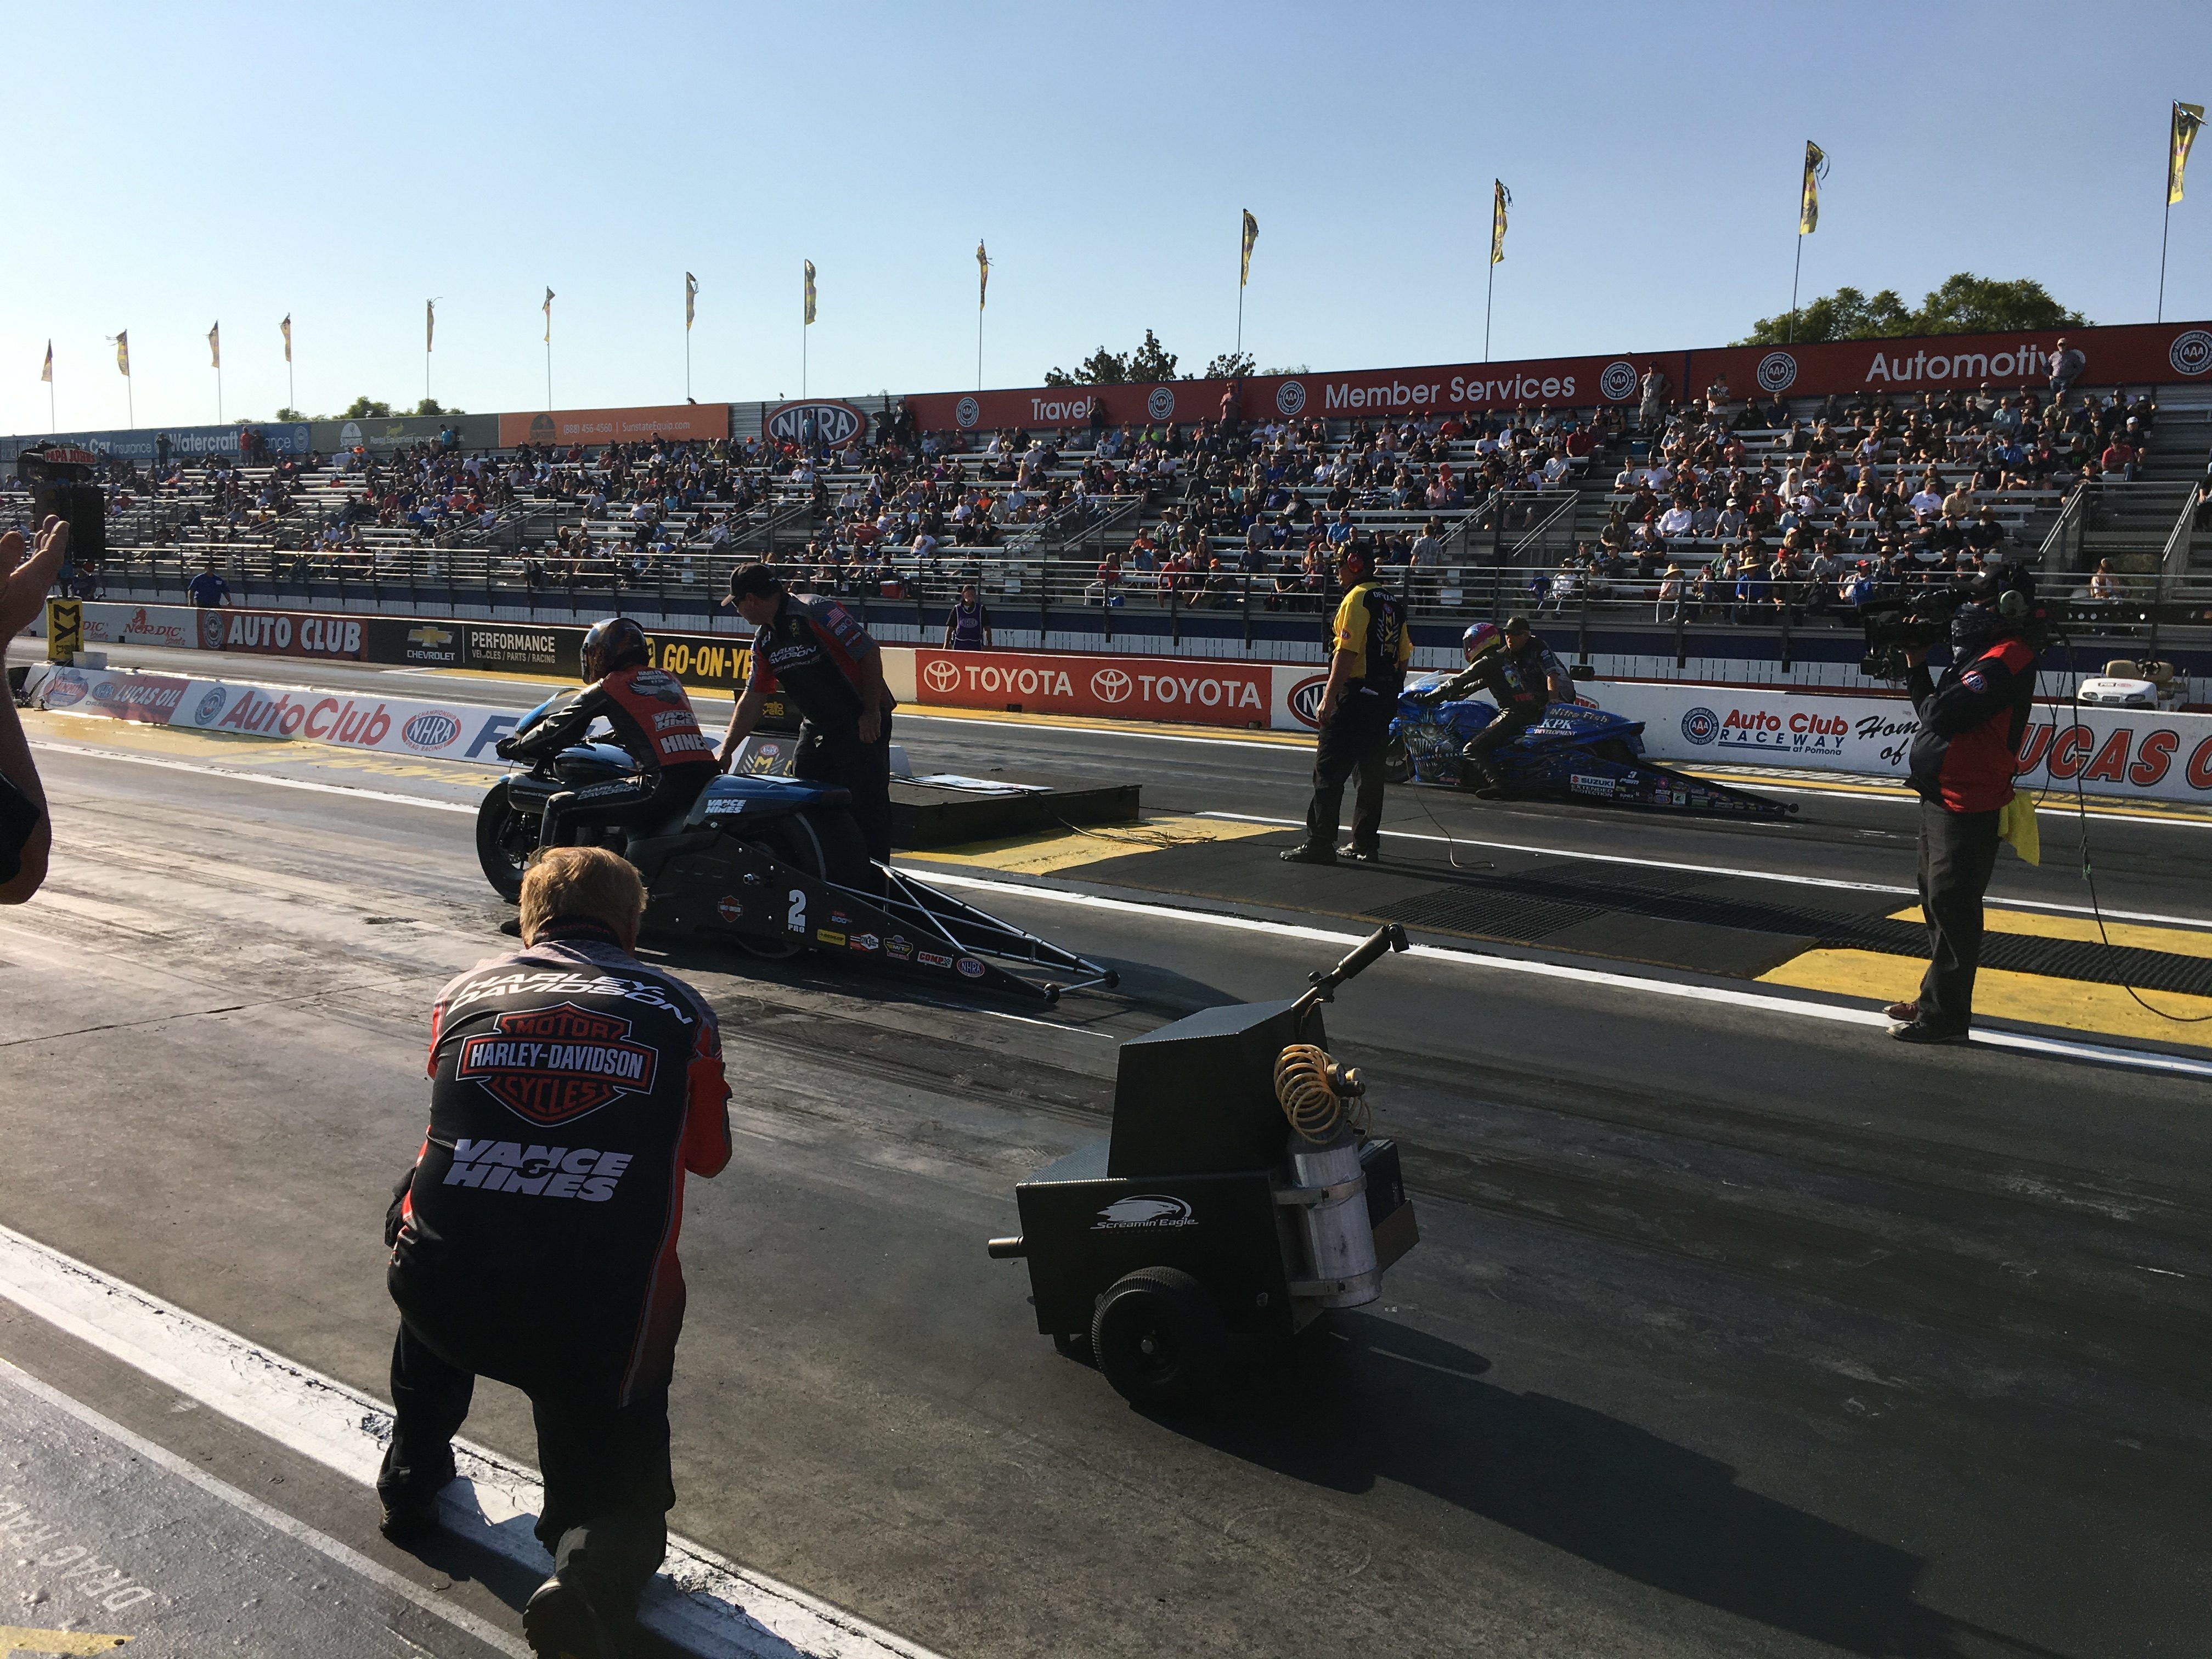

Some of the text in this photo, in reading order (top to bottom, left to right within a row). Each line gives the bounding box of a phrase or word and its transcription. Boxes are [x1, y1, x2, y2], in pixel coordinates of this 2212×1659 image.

[2183, 346, 2204, 357] AAA
[1865, 344, 2086, 382] Automoti
[1768, 366, 1785, 376] AAA
[1611, 375, 1626, 384] AAA
[1285, 392, 1297, 401] AAA
[1325, 373, 1576, 409] Member Services
[1031, 396, 1091, 421] Travel
[1155, 398, 1166, 407] AAA
[563, 421, 691, 435] (888) 456-4560 SunstateEquip.com
[777, 408, 850, 445] NHRA
[113, 441, 152, 454] Insurance
[169, 431, 239, 452] Watercraft
[46, 449, 68, 461] PAPA
[1373, 591, 1397, 602] OFCIAL
[123, 623, 181, 636] NORDIC
[227, 616, 362, 652] AUTO CLUB
[471, 631, 556, 653] PERFORMANCE
[407, 650, 455, 661] CHEVROLET
[507, 653, 527, 662] PARTS
[532, 654, 556, 664] RACING
[769, 645, 804, 658] ARLEY-
[663, 644, 752, 680] GO-ON-YE
[964, 665, 1074, 697] TOYOTA
[113, 685, 183, 708] LUCAS OIL
[1137, 675, 1262, 710] TOYOTA
[417, 709, 456, 720] CHAMPIONSHIP
[1540, 719, 1574, 730] KPK
[1691, 720, 1708, 731] AAA
[1723, 709, 1849, 736] Auto Club
[1855, 715, 1921, 740] Hom
[409, 717, 453, 744] NHRA
[1719, 729, 1845, 748] RACEWAY
[405, 741, 443, 752] DRAG RACING
[1804, 746, 1842, 756] Pomona
[1880, 737, 1909, 766] of
[2012, 723, 2180, 787] UCAS
[1571, 785, 1613, 793] EXTENDED
[1581, 778, 1613, 787] SUZUKI
[577, 786, 641, 800] DAVIDSON
[1571, 788, 1613, 797] PROTECTION
[705, 806, 743, 814] HINES
[707, 799, 747, 808] VANCE
[788, 889, 806, 927] 2
[788, 924, 805, 933] PRO
[919, 952, 944, 964] COMP
[961, 961, 981, 974] NHRA
[459, 972, 666, 998] HARLEY-
[446, 982, 693, 1025] DAVIDSON
[515, 1012, 613, 1039] MOTOR
[470, 1042, 645, 1079] HARLEY-DAVIDSON
[504, 1076, 597, 1113] CYCLES
[453, 1138, 634, 1177] VANCE
[442, 1161, 619, 1203] HINES
[1090, 1216, 1199, 1229] Screamin' Eagle
